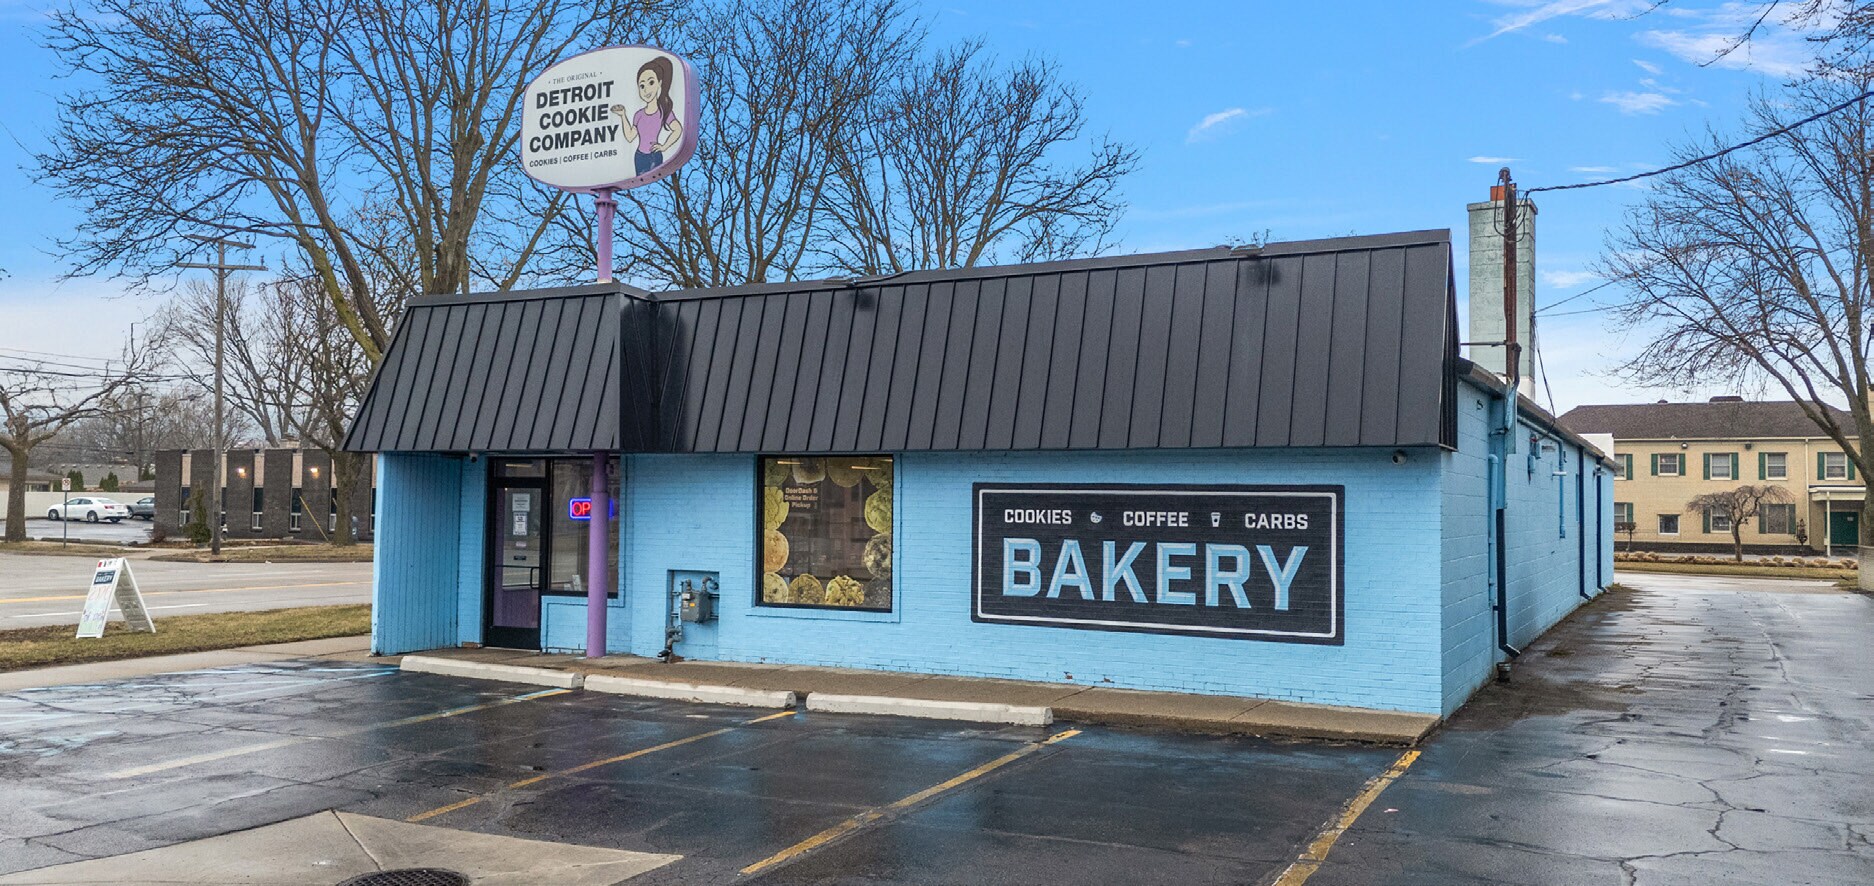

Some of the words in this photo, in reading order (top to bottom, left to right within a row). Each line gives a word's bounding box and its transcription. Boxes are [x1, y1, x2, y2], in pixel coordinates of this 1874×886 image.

[566, 72, 597, 82] ORIGINAL
[536, 80, 614, 109] DETROIT
[539, 103, 609, 130] COOKIE
[529, 124, 619, 153] COMPANY
[529, 157, 558, 168] COOKIES
[563, 152, 589, 163] COFFEE
[594, 149, 618, 159] CARBS
[1004, 508, 1072, 525] COOKIES
[1122, 511, 1189, 527] COFFEE
[1244, 513, 1309, 530] CARBS
[1002, 537, 1310, 611] BAKERY
